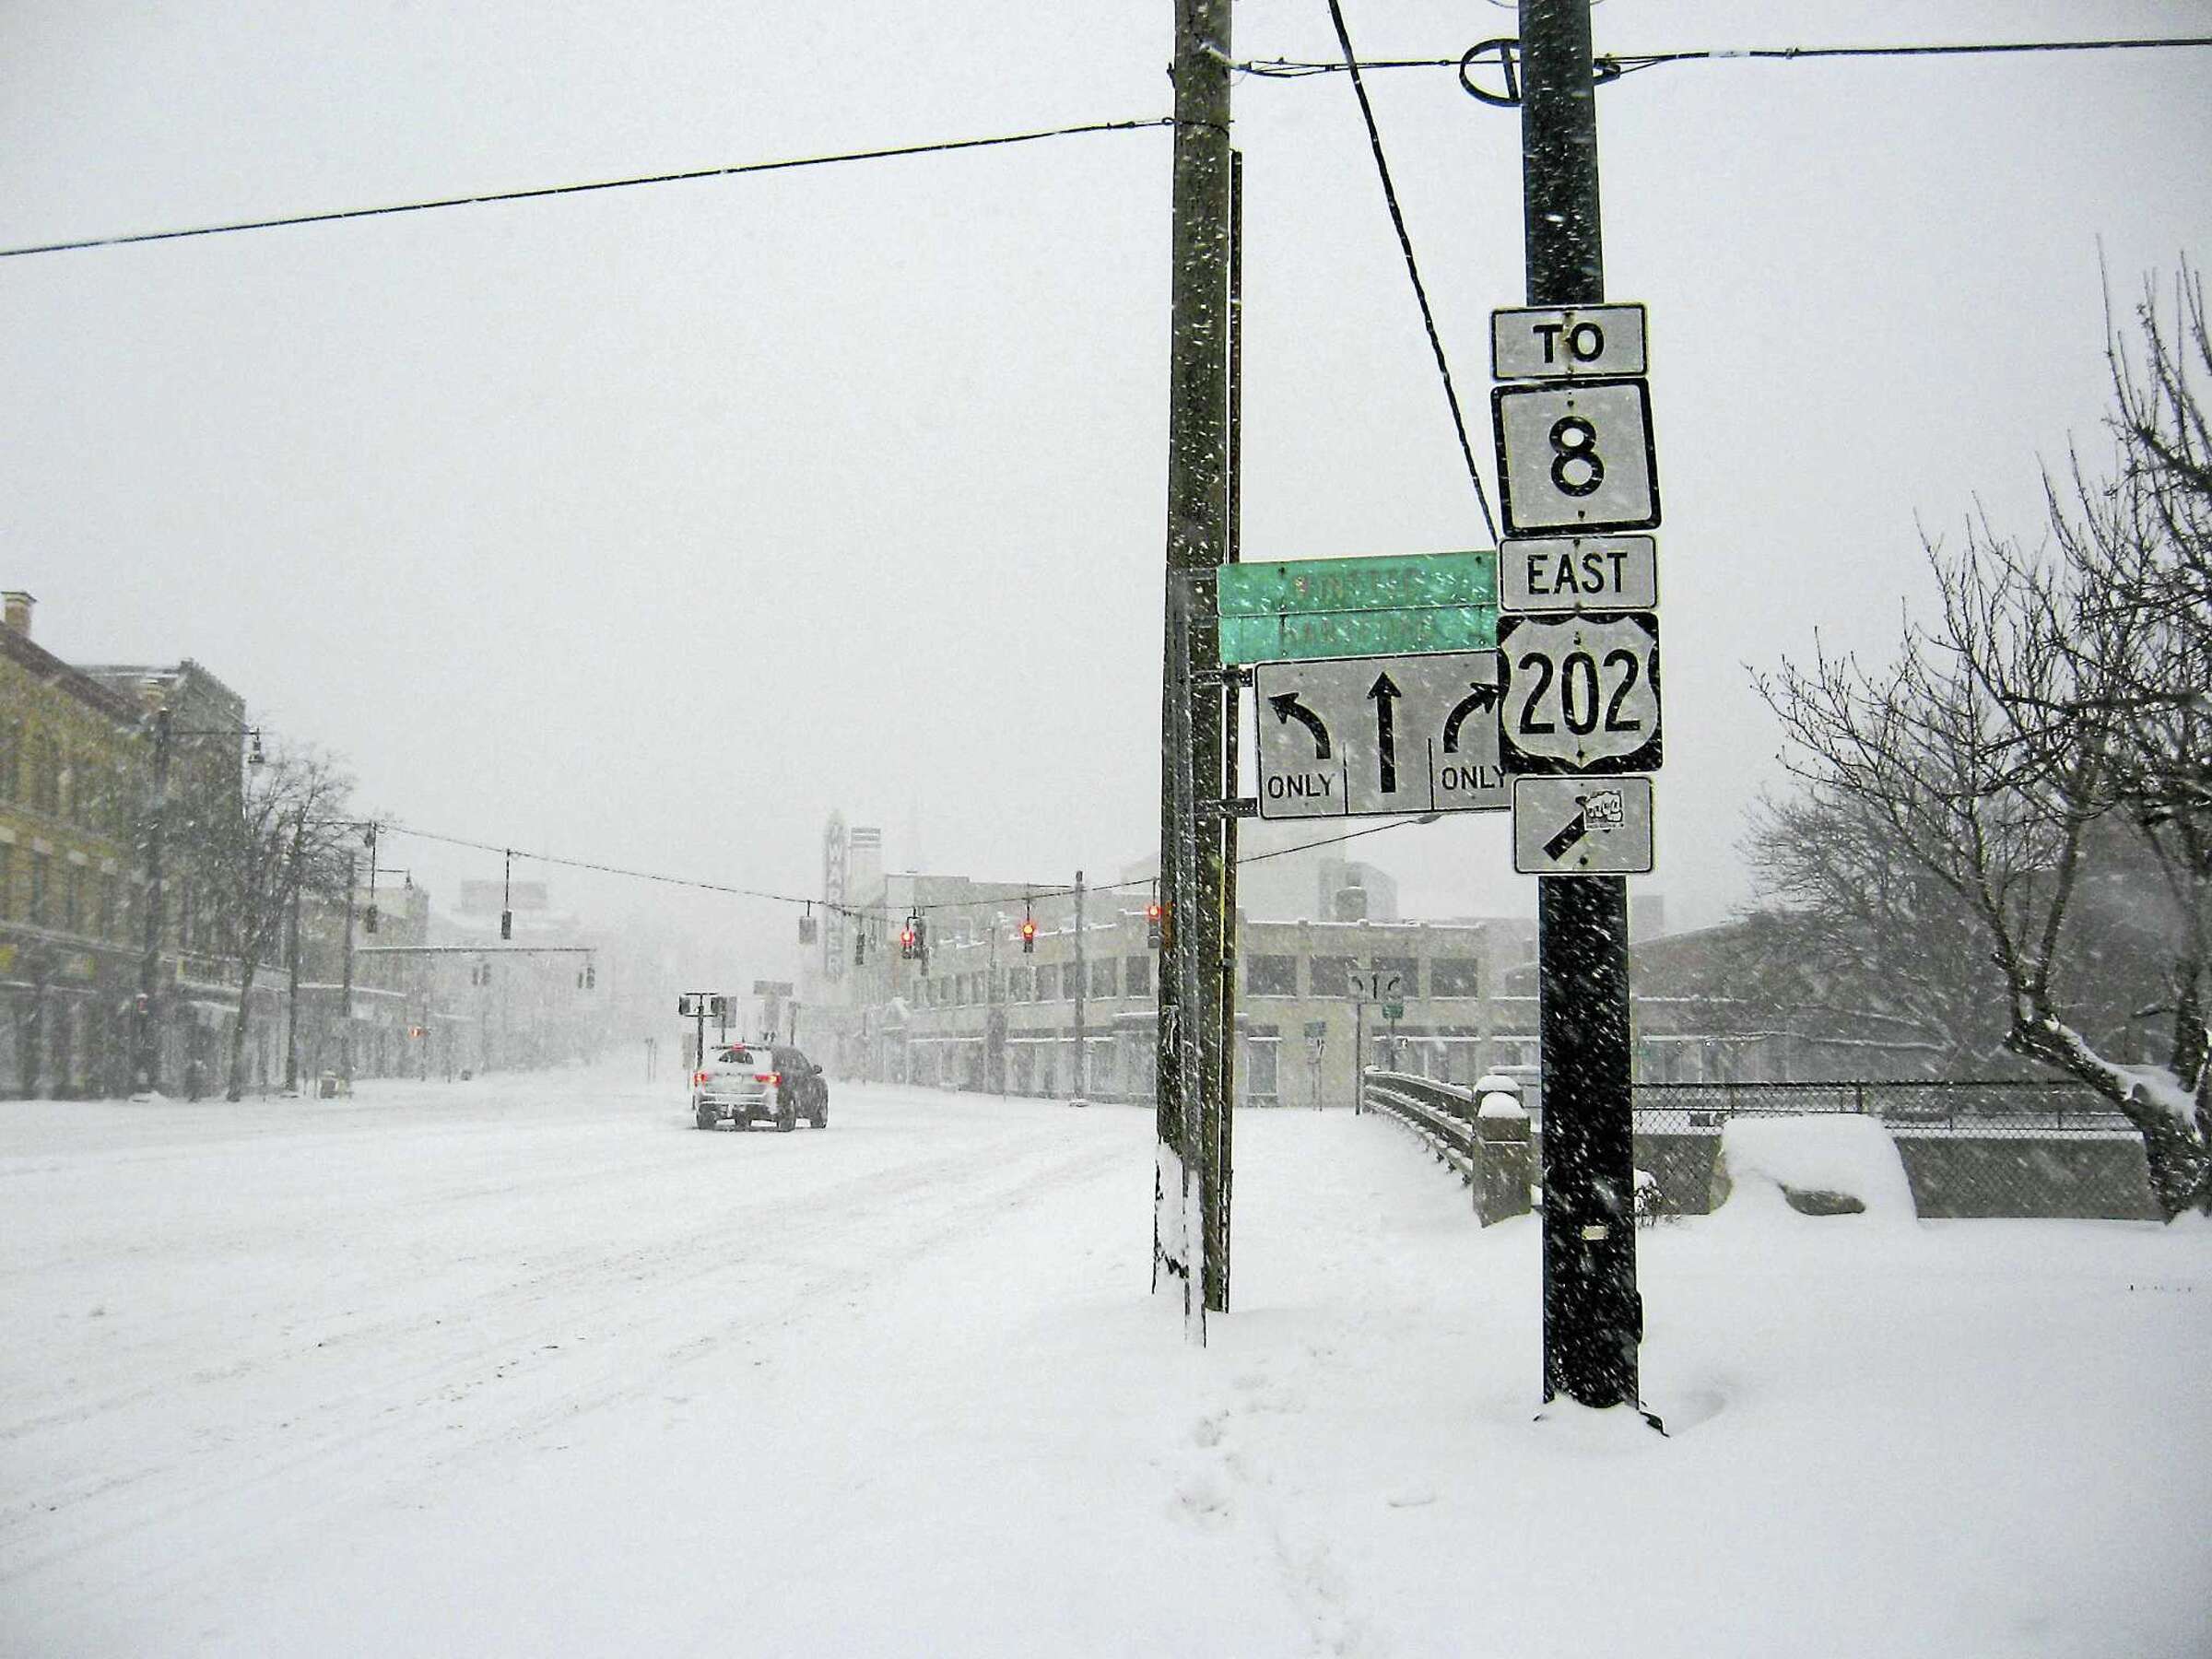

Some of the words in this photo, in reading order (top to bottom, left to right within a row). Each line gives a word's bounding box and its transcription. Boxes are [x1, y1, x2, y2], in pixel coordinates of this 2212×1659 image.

[1533, 322, 1605, 363] TO
[1549, 416, 1605, 497] 8
[1527, 552, 1628, 594] EAST
[1518, 649, 1641, 735] 202
[1267, 773, 1335, 798] ONLY
[1441, 765, 1508, 791] ONLY
